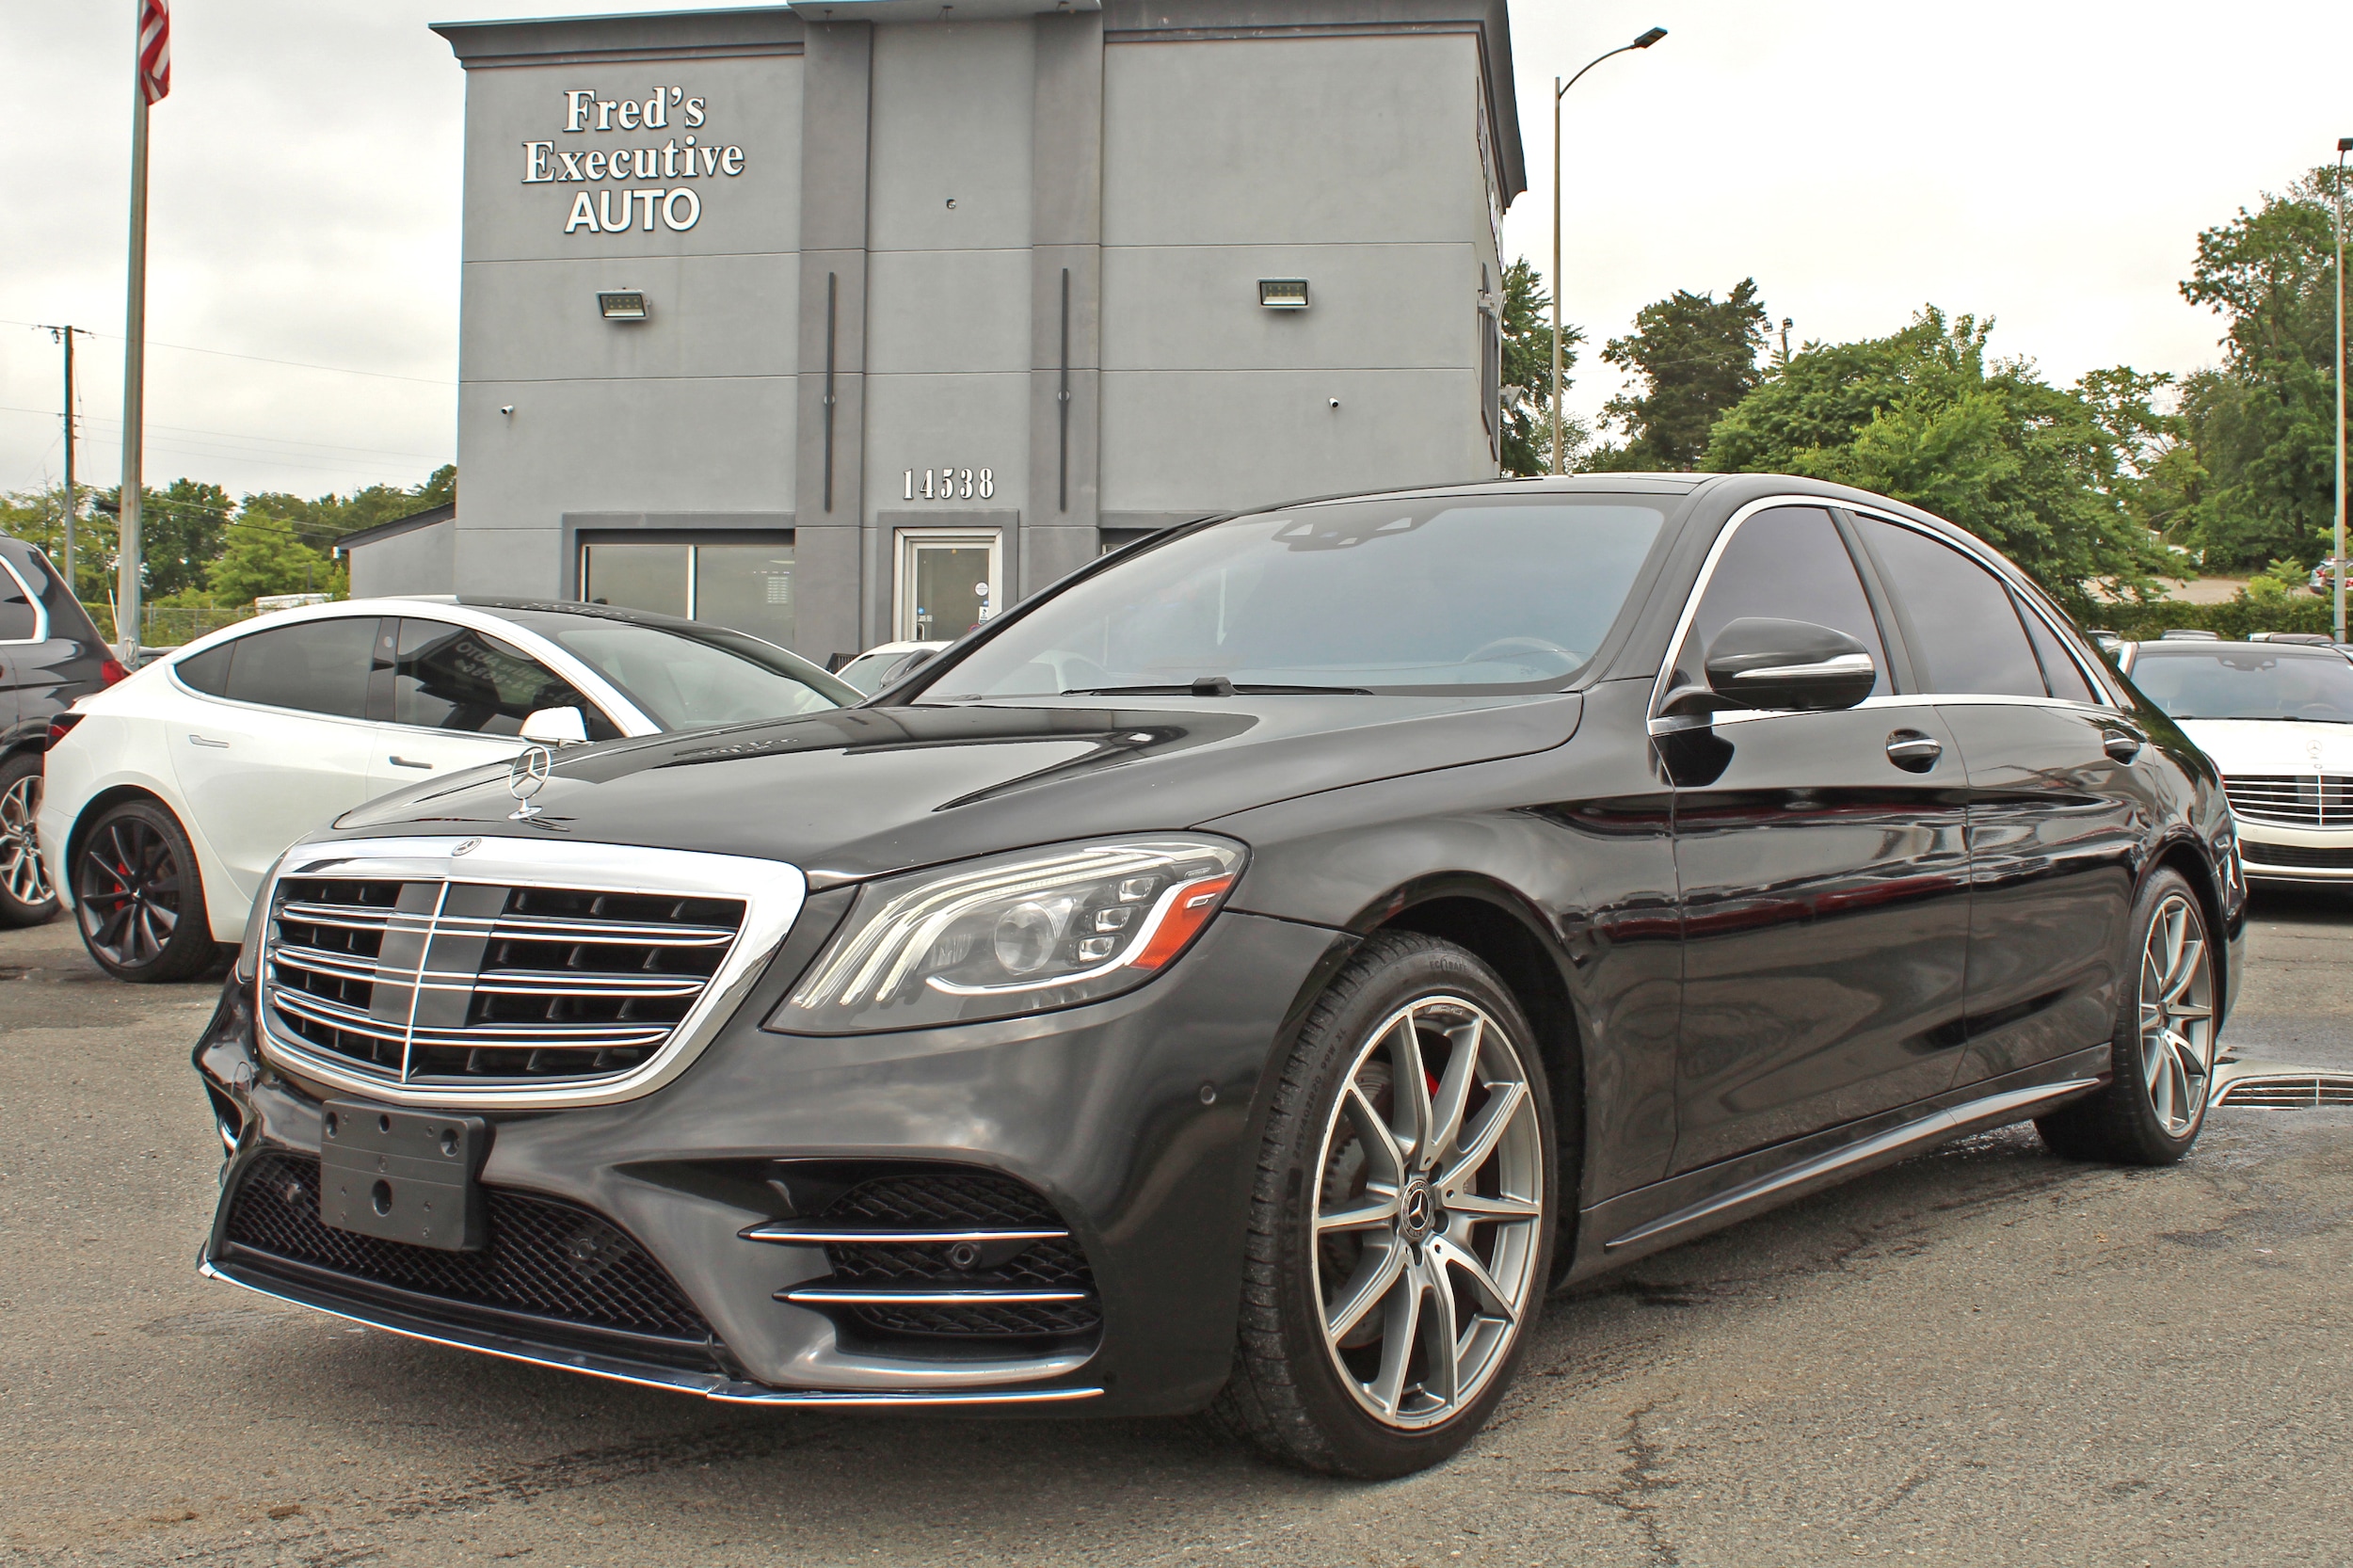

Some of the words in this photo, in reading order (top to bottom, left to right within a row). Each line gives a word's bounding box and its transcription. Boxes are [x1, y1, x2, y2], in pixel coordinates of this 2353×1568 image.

[563, 86, 706, 132] Fred's
[521, 135, 745, 184] Executive
[564, 186, 701, 233] AUTO
[903, 468, 995, 500] 14538
